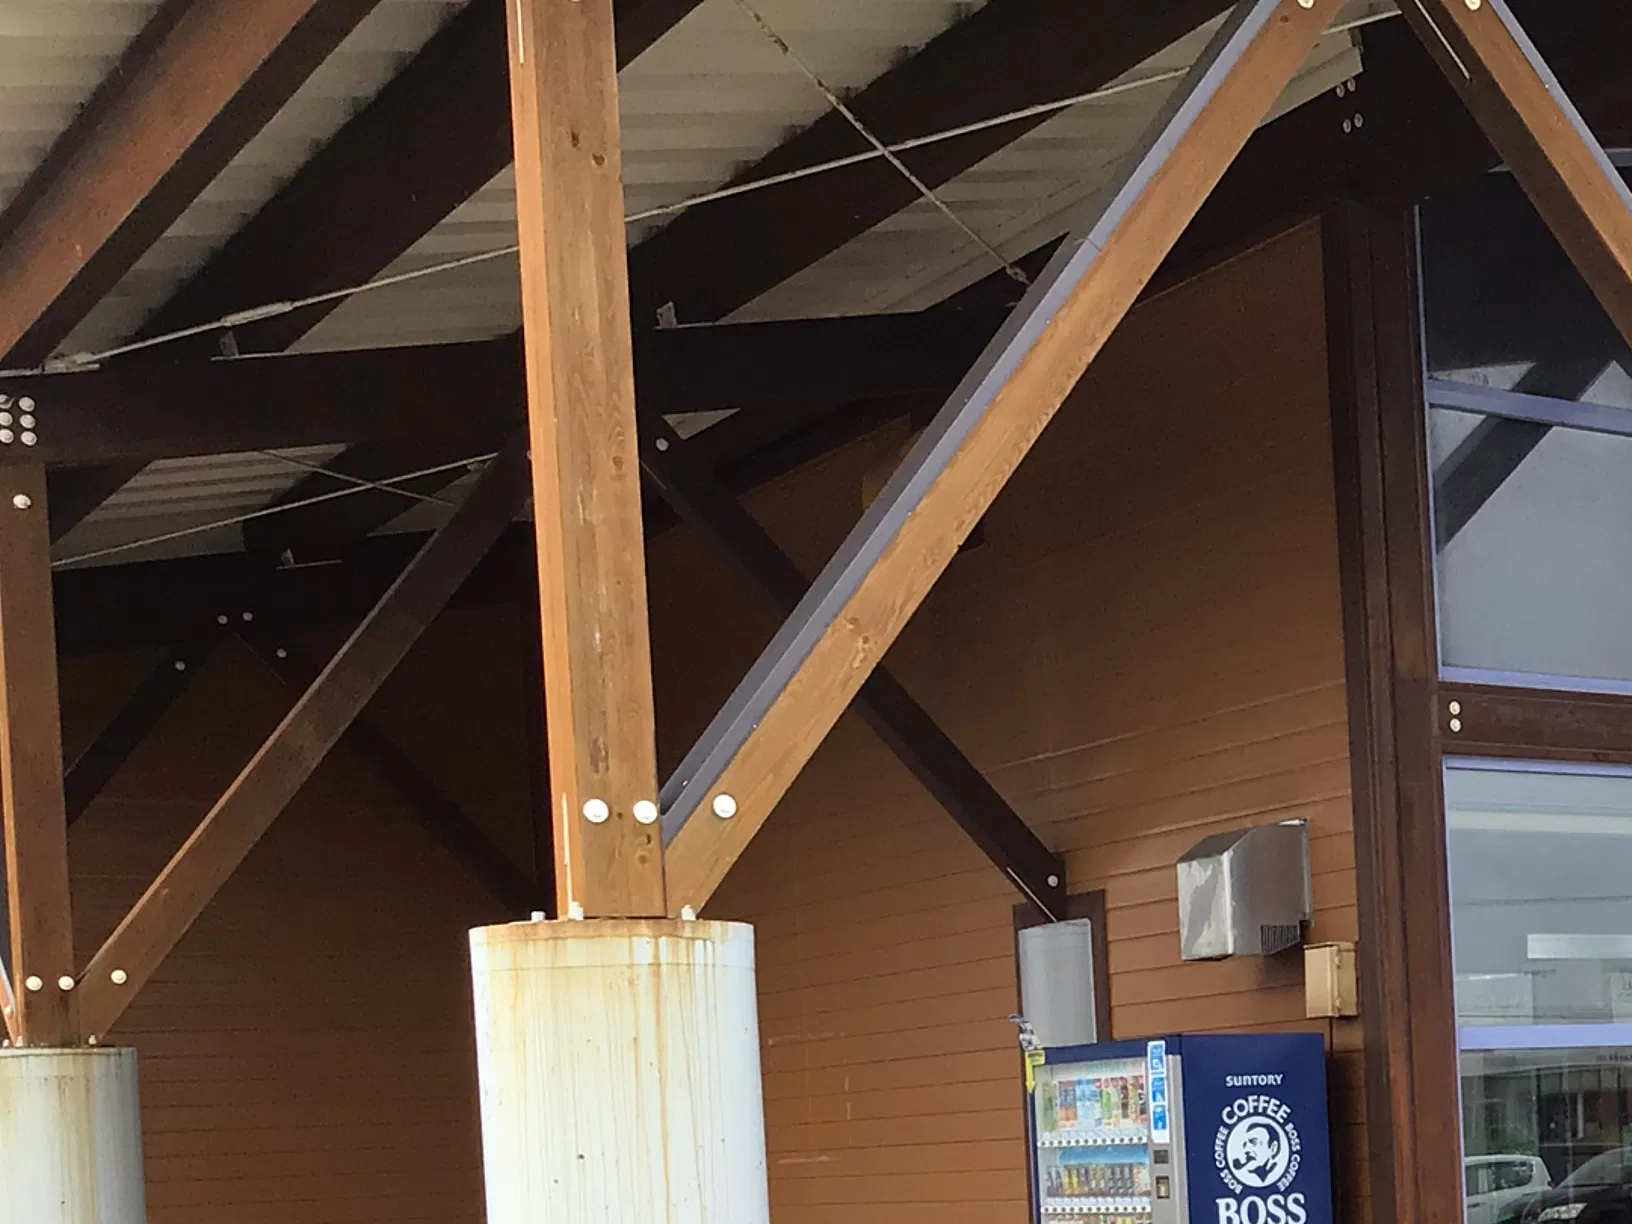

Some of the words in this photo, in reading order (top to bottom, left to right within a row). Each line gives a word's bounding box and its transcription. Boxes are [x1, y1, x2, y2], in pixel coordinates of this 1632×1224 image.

[1225, 1074, 1284, 1087] SUNTORY
[1221, 1095, 1292, 1124] COFFEE
[1214, 1125, 1229, 1169] COFFEE
[1285, 1122, 1301, 1152] BOSS
[1220, 1169, 1243, 1195] BOSS
[1276, 1154, 1301, 1192] COFFEE
